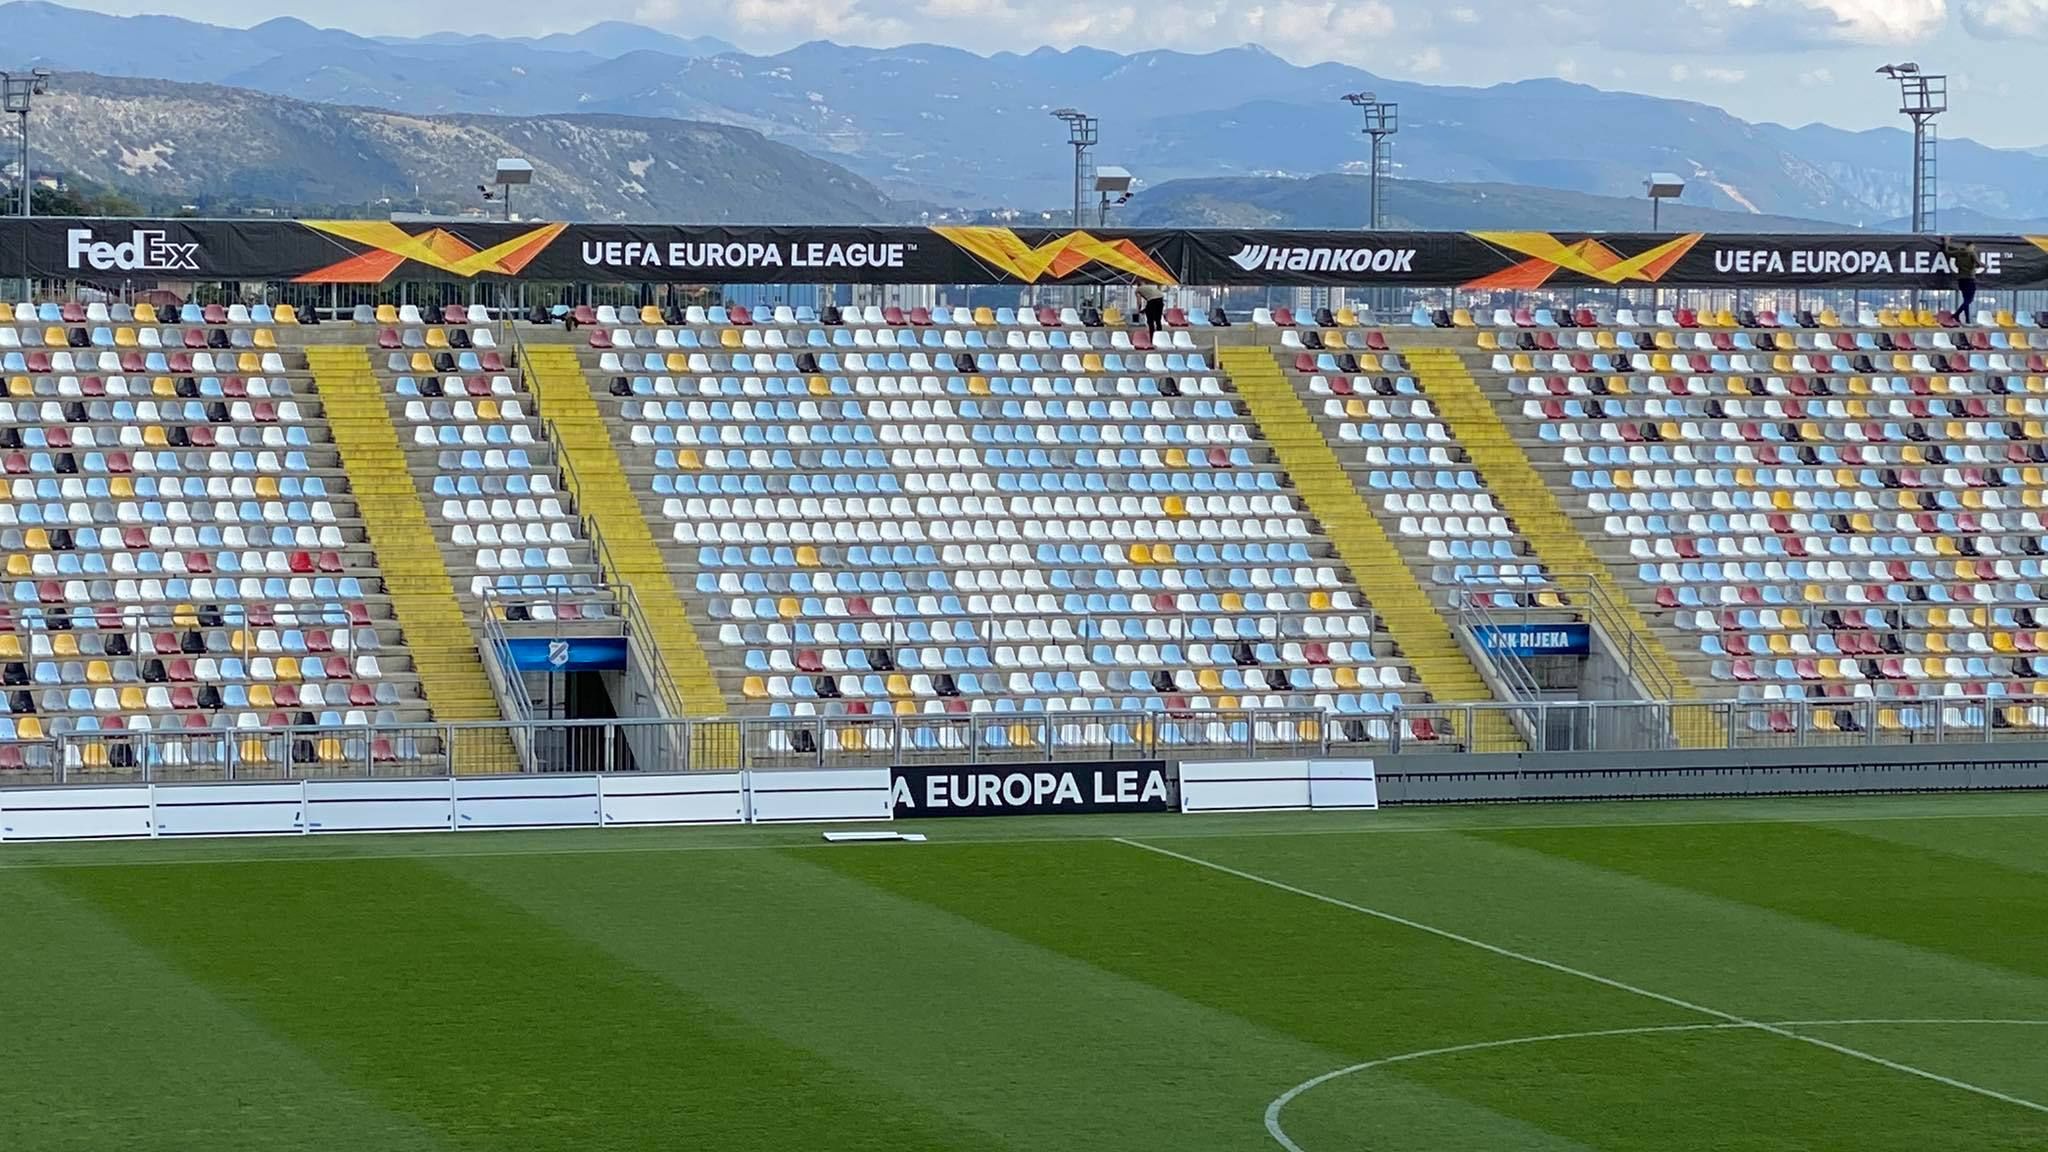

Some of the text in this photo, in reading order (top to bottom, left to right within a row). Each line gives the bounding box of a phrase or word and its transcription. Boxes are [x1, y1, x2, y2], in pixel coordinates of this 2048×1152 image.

[67, 229, 199, 269] FedEx
[581, 241, 662, 266] UEFA
[668, 243, 784, 267] EUROPA
[1715, 250, 1785, 273] UEFA
[1791, 251, 1893, 274] EUROPA
[1520, 631, 1569, 648] RIJEKA
[926, 772, 1084, 808] EUROPA
[1094, 770, 1168, 803] LEA
